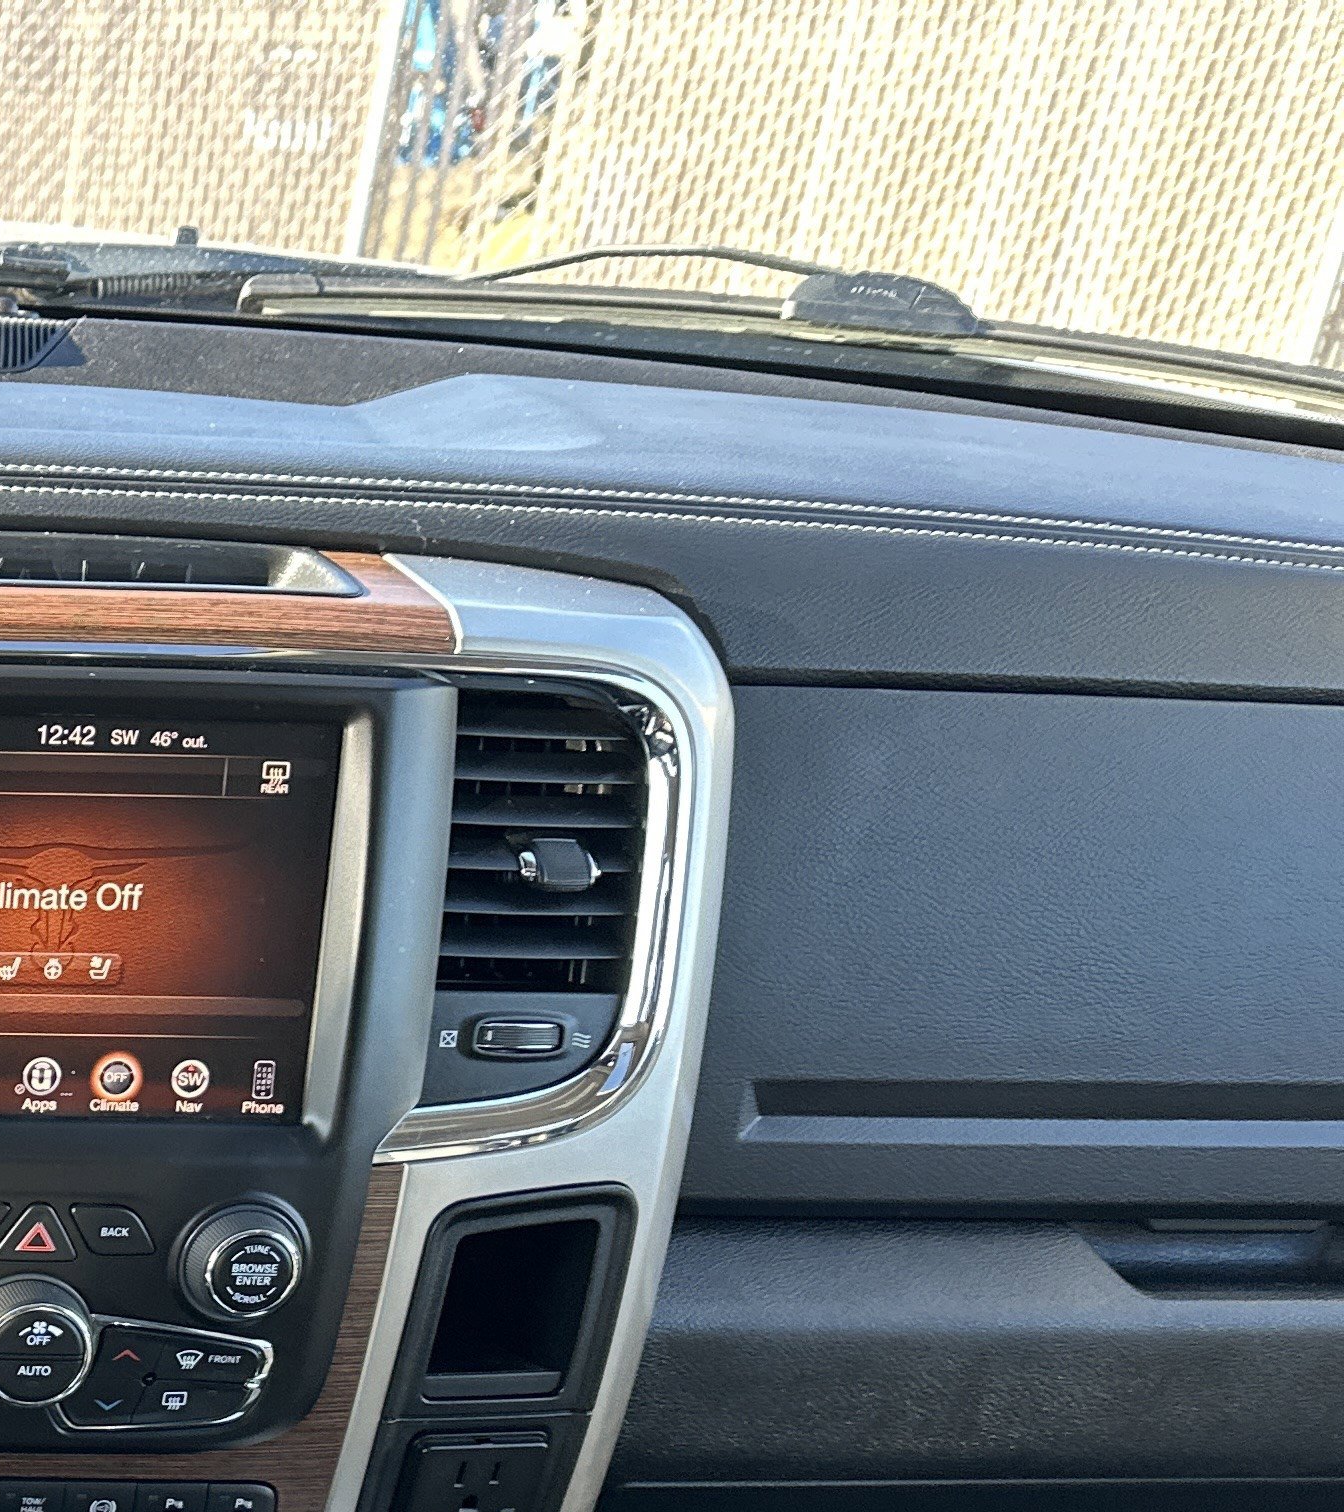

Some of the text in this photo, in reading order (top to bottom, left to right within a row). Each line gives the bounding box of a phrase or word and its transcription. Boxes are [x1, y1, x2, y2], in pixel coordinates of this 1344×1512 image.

[37, 725, 97, 747] 12:42
[110, 729, 140, 747] SW
[150, 730, 208, 750] 46° out.
[260, 783, 289, 795] REAR
[95, 881, 144, 912] Off
[103, 1071, 128, 1084] OFF
[177, 1072, 204, 1087] SW
[21, 1097, 57, 1114] Apps
[89, 1098, 139, 1113] Climate
[175, 1100, 203, 1113] Nav
[241, 1100, 284, 1116] Phone
[100, 1226, 130, 1238] BACK
[244, 1244, 271, 1256] TUNE
[231, 1263, 279, 1274] BROWSE
[235, 1275, 272, 1287] ENTER
[231, 1292, 268, 1304] SCROLL
[25, 1334, 51, 1347] OFF
[207, 1354, 242, 1365] FRONT
[17, 1365, 52, 1377] AUTO
[21, 1496, 47, 1506] TOW/
